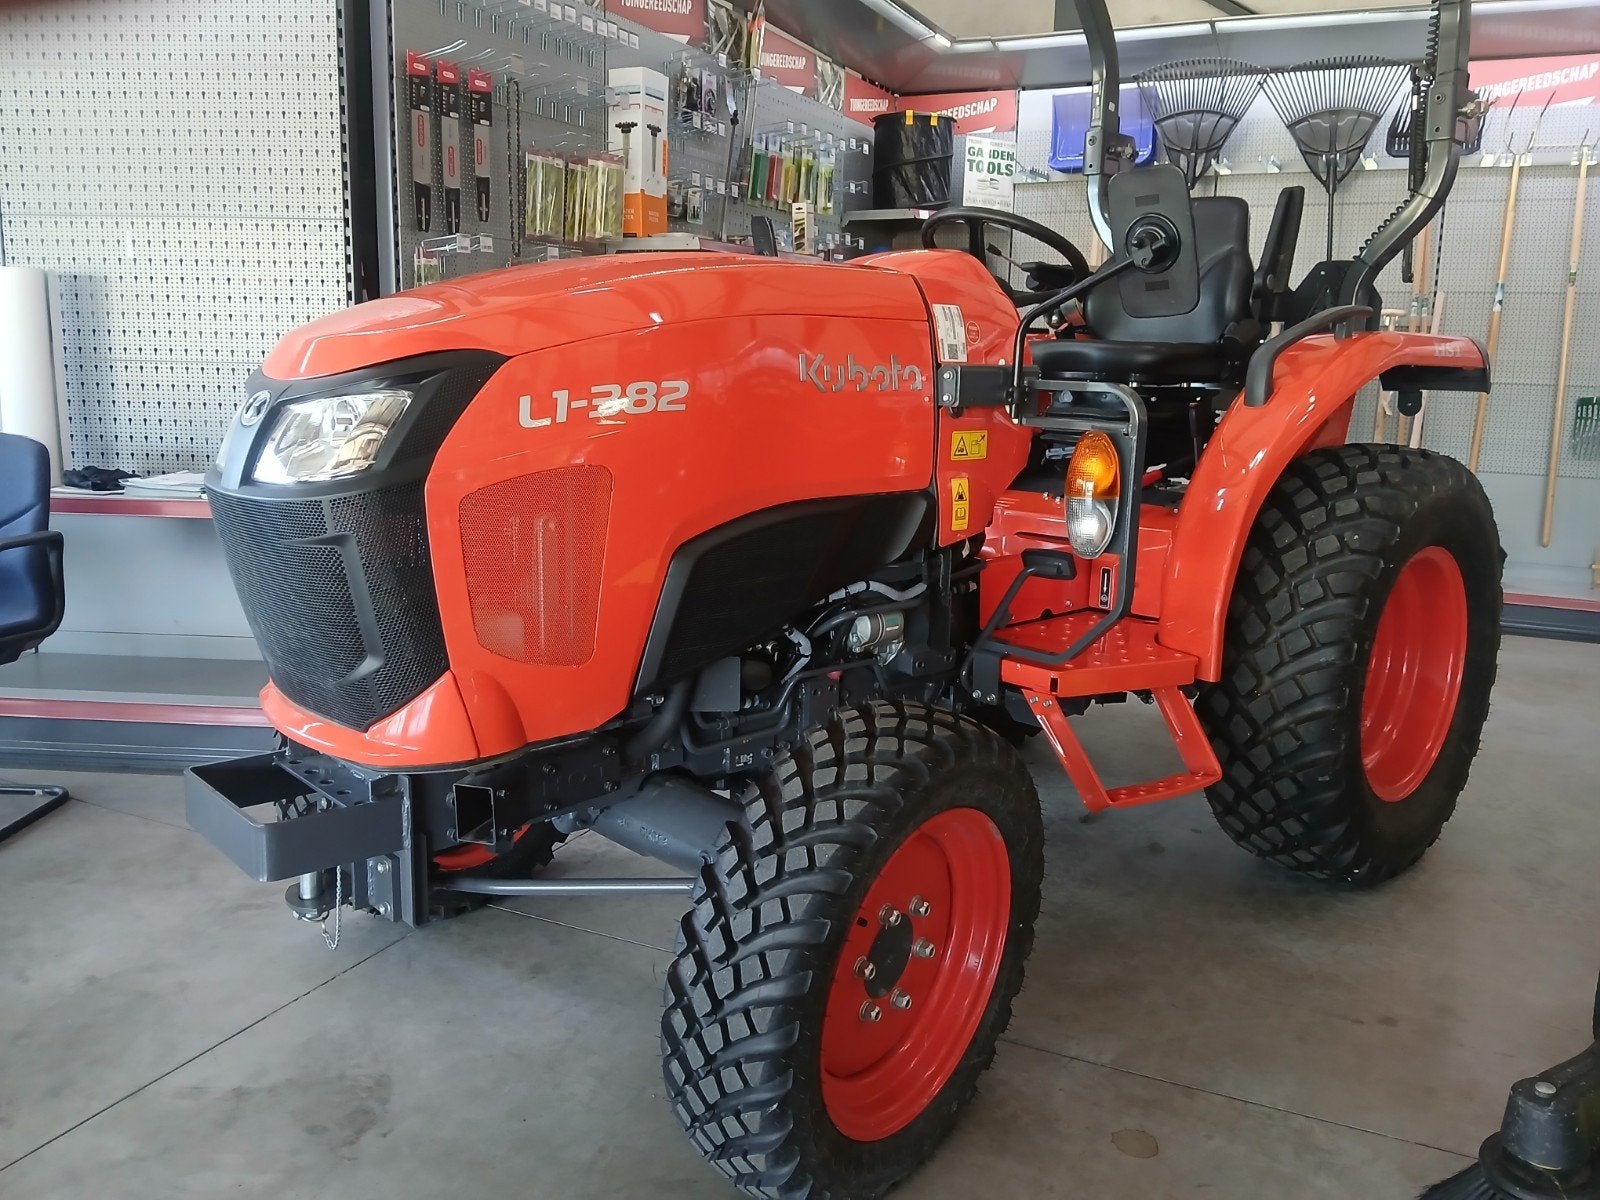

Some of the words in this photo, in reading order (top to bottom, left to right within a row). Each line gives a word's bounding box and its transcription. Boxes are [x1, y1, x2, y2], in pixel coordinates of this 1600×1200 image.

[967, 159, 1014, 177] TOOLS
[799, 353, 923, 392] Kubota
[518, 379, 689, 428] L1-382
